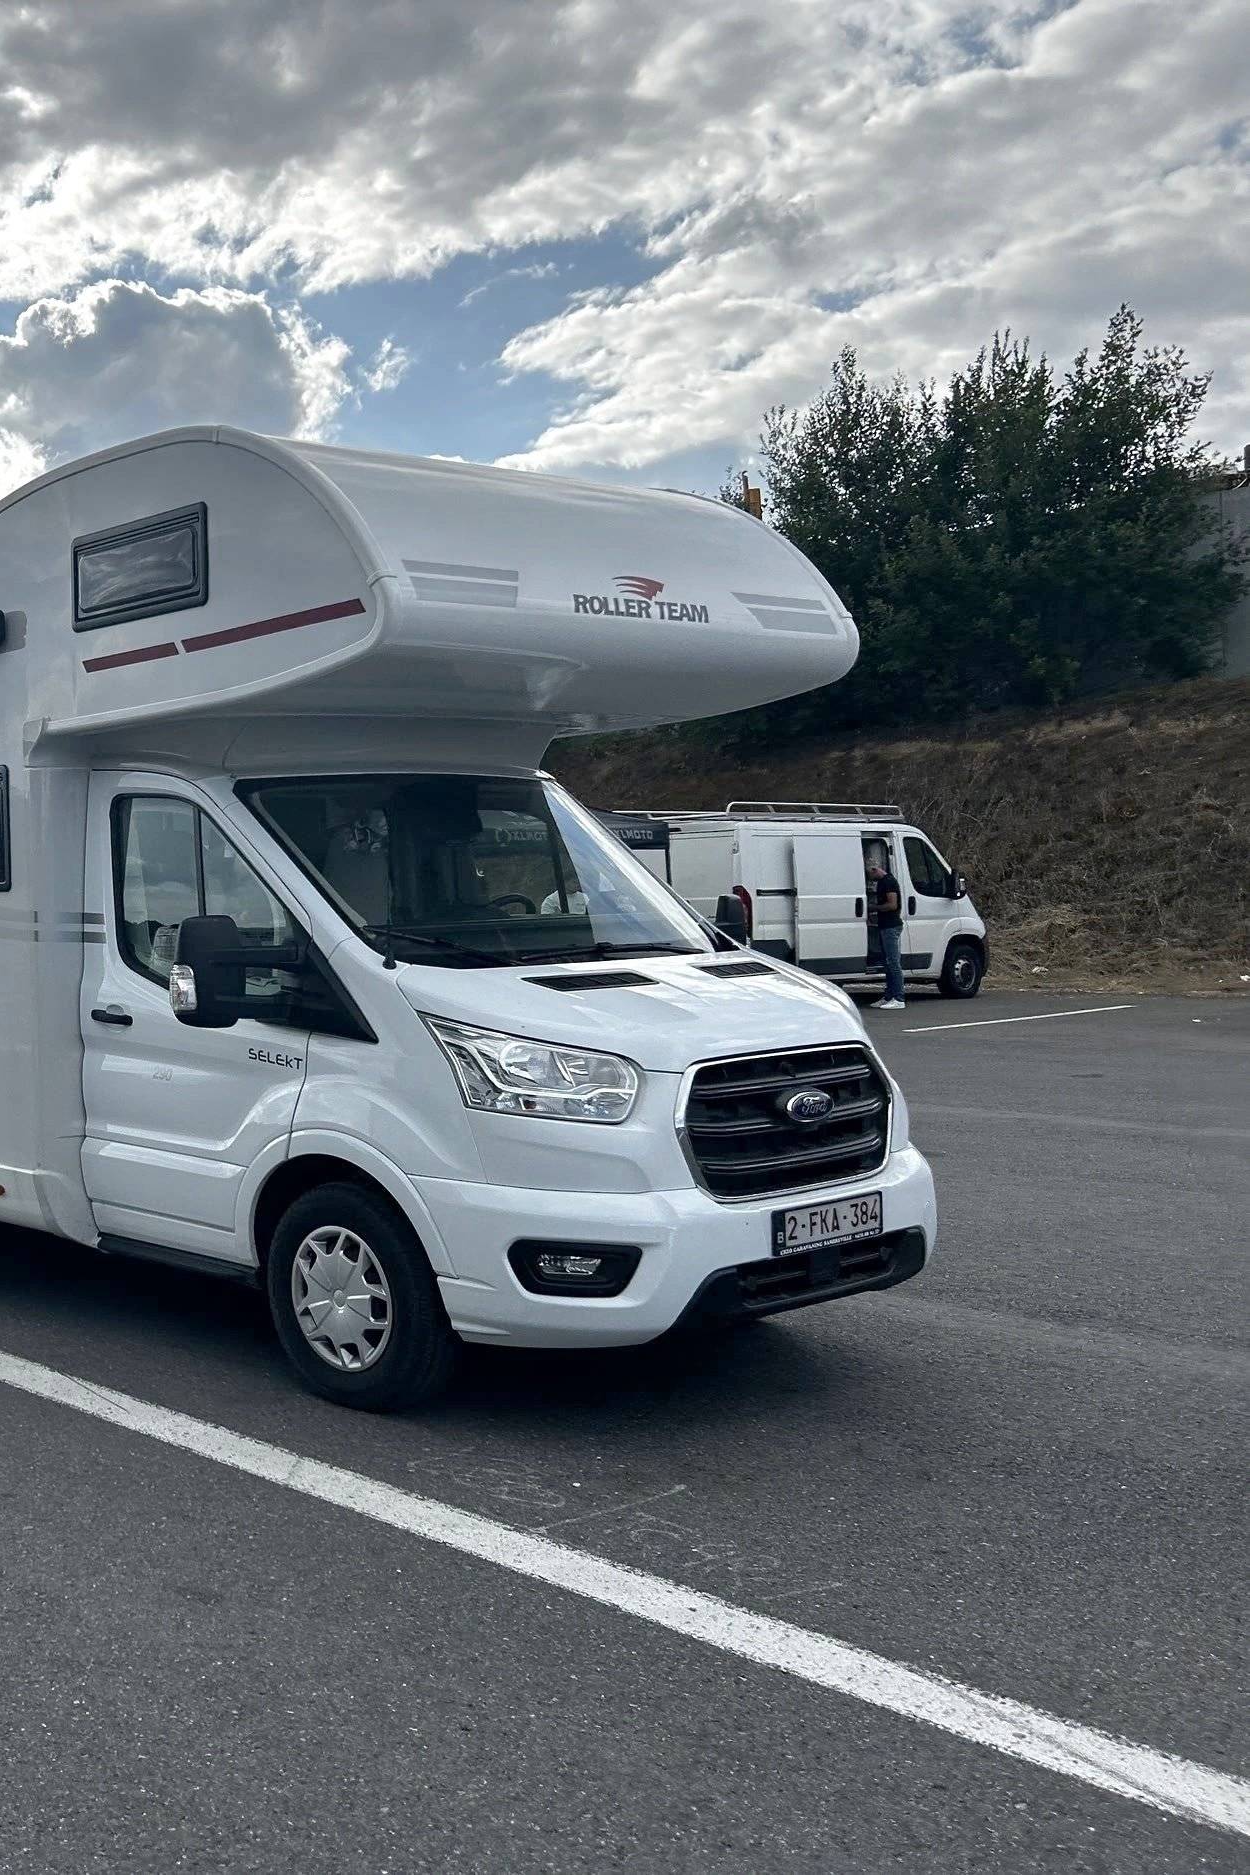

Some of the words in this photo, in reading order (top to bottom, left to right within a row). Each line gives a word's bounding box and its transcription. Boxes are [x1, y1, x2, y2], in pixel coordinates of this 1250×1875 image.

[573, 594, 652, 618] ROLLER
[654, 601, 709, 623] TEAM
[248, 1048, 303, 1069] SELEKT
[802, 1096, 828, 1114] Ford
[787, 1199, 879, 1241] 2-FKA-384
[777, 1232, 784, 1243] B
